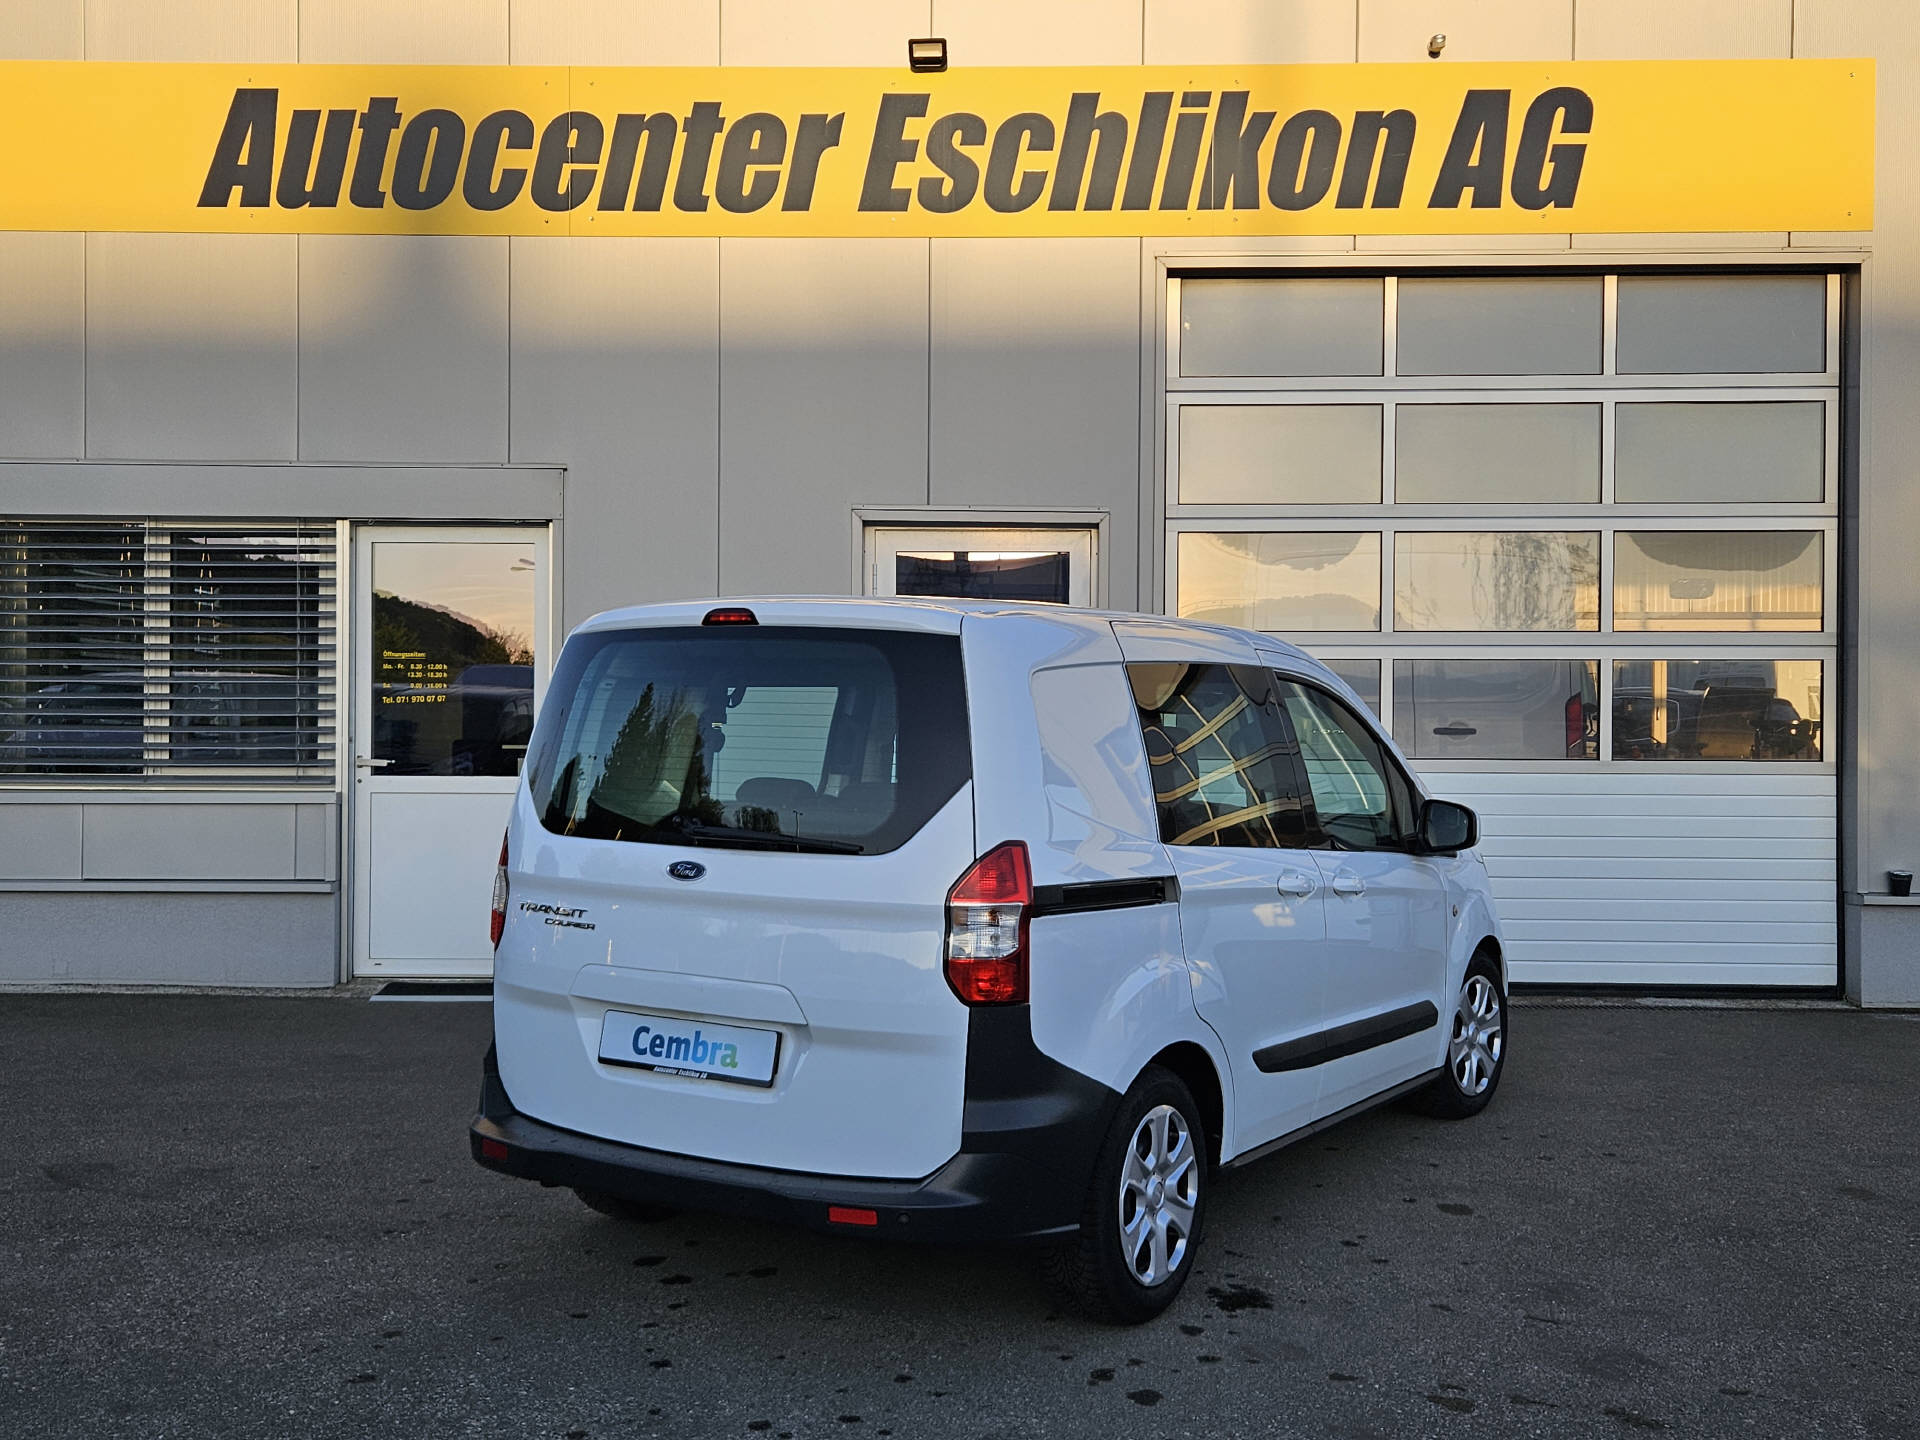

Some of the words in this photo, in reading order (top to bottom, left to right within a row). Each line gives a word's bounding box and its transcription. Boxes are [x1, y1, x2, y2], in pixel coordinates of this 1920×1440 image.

[197, 88, 845, 213] Autocenter
[858, 91, 1416, 212] Eschlikon
[1428, 86, 1594, 210] AG
[674, 863, 697, 877] Ford
[519, 901, 588, 918] TRANSIT
[544, 917, 596, 931] COURIER
[632, 1026, 738, 1069] Cembra
